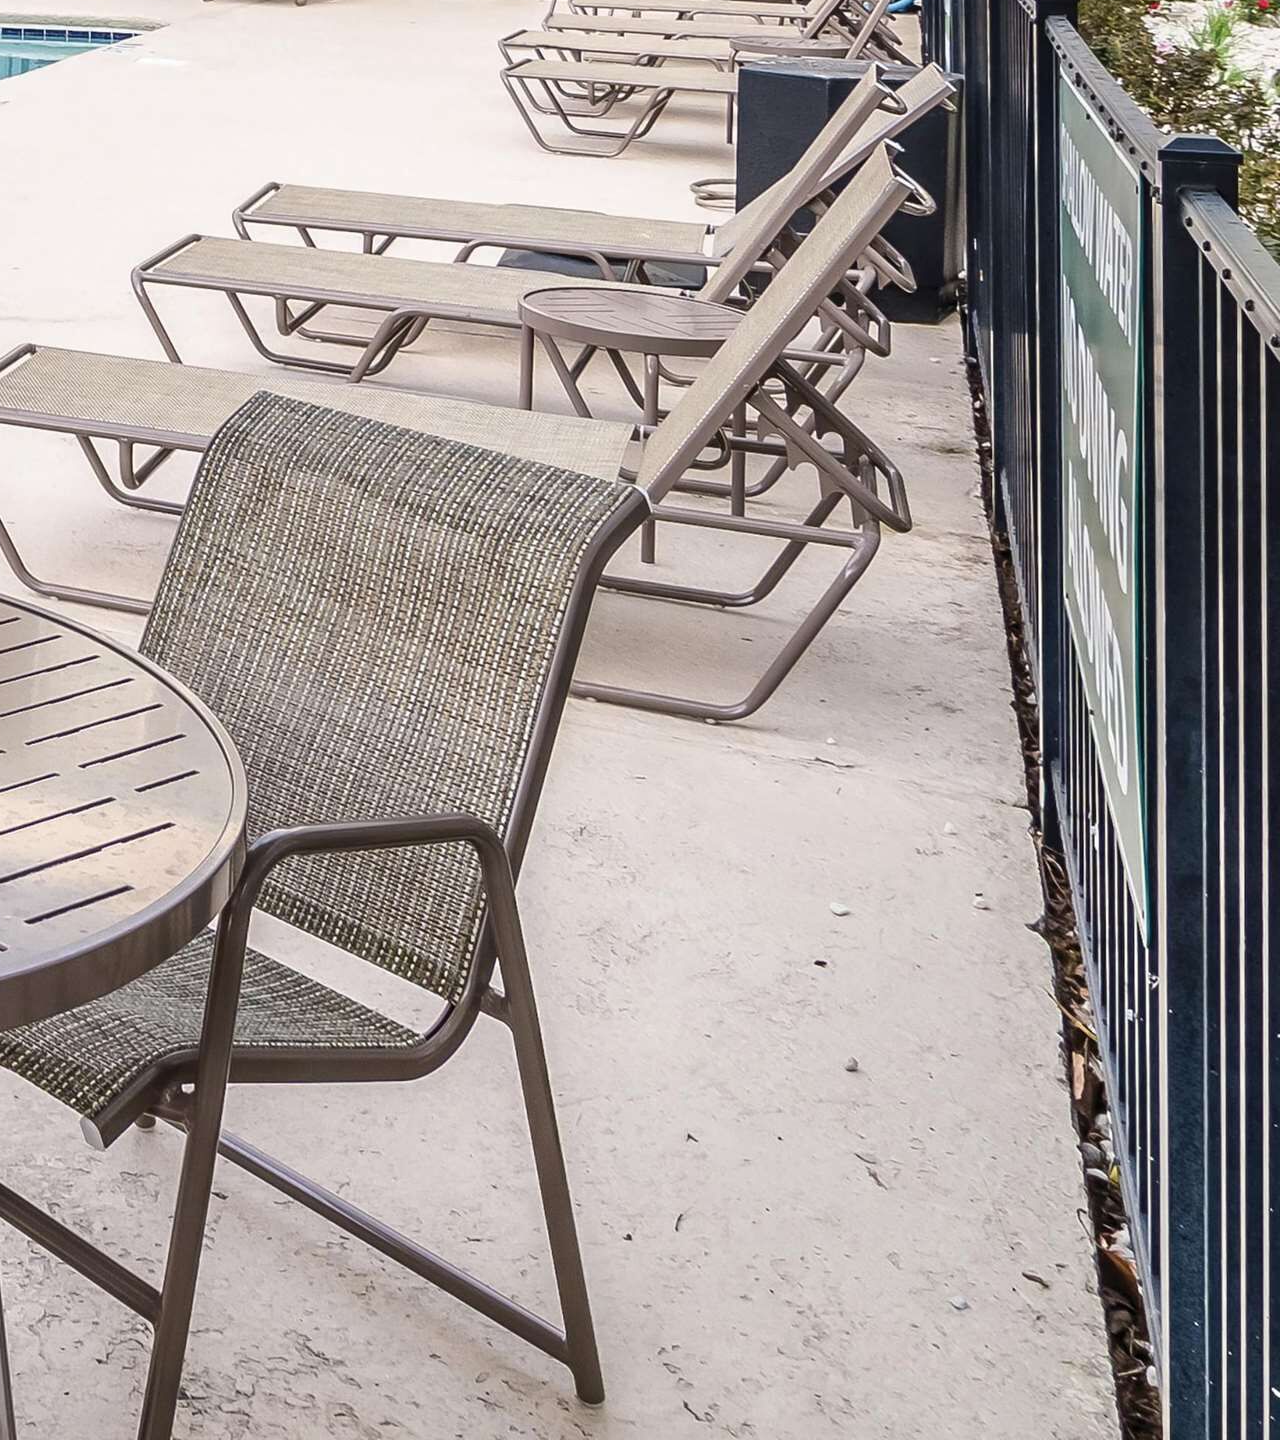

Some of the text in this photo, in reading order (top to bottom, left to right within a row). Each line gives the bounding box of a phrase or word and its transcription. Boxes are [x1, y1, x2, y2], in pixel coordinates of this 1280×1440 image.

[1061, 122, 1134, 347] SHALLOW WATER
[1062, 272, 1128, 596] NO DIVING
[1068, 459, 1129, 797] ALLOWED
